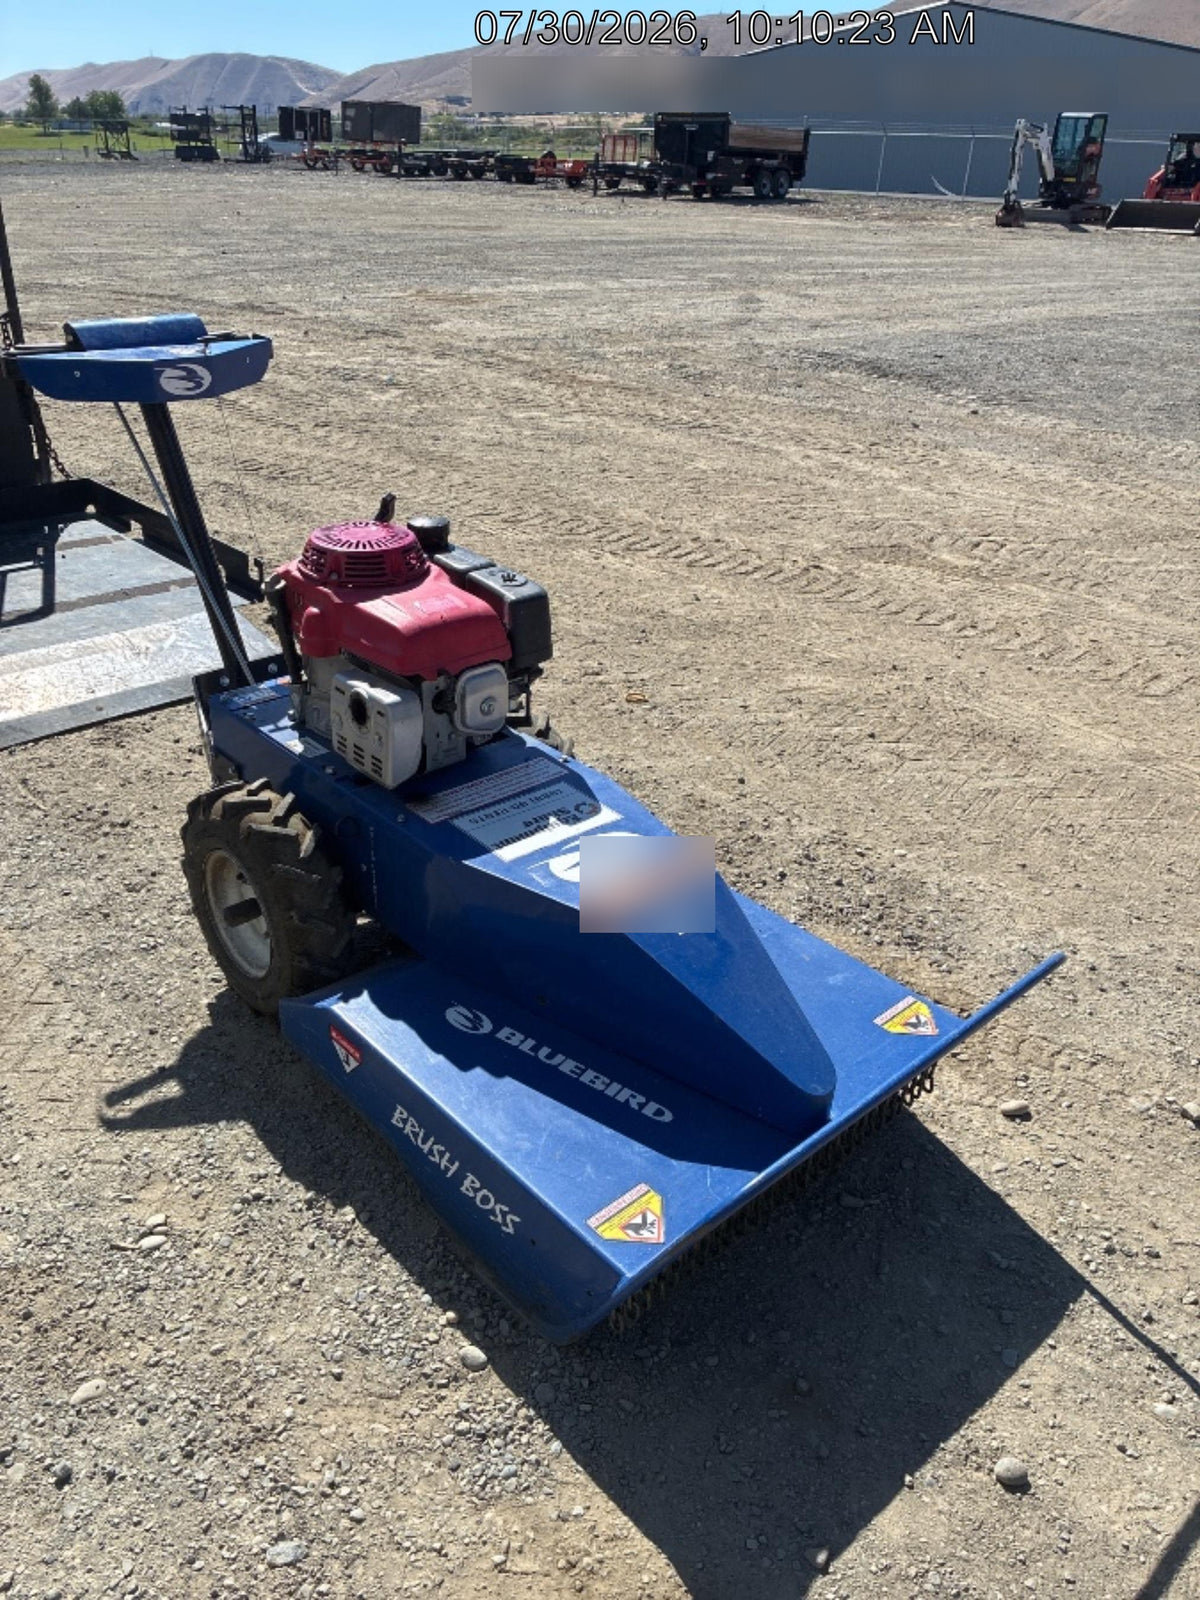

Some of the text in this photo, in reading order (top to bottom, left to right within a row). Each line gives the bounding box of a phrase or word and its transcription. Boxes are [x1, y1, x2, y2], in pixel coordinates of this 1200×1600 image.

[495, 1026, 674, 1123] BLUEBIRD
[391, 1104, 460, 1178] BRUSH
[459, 1172, 522, 1235] BOSS
